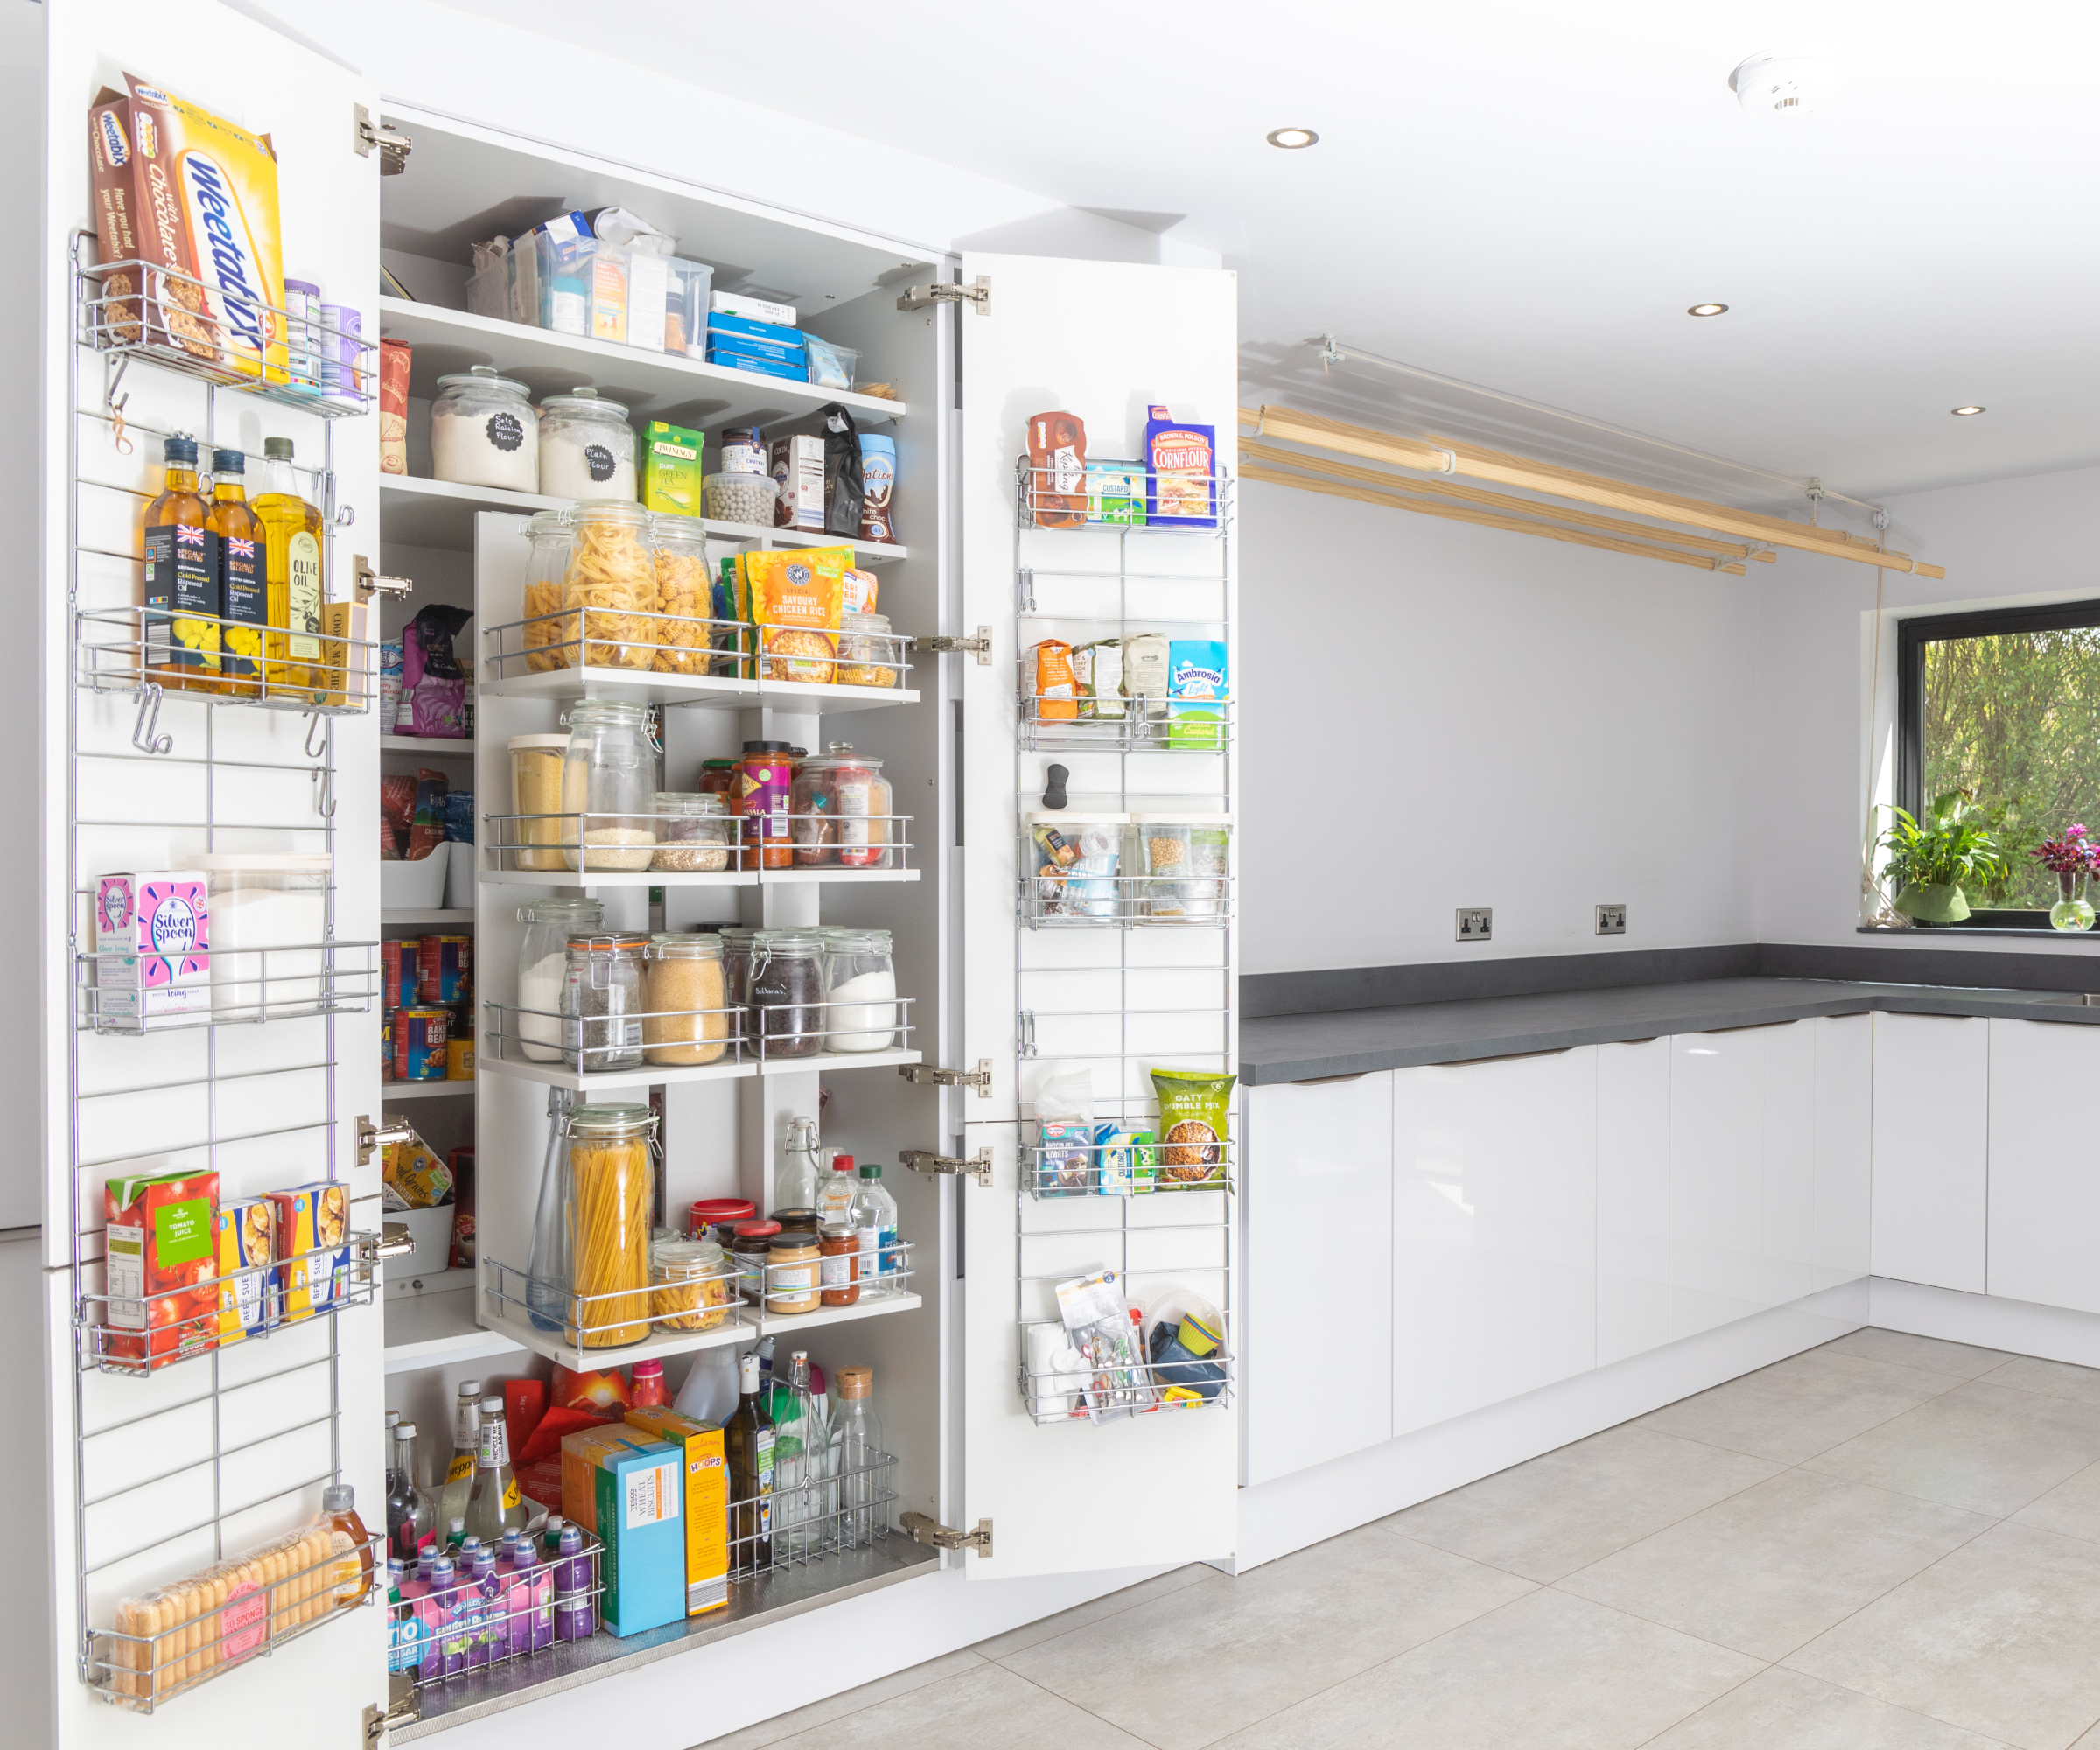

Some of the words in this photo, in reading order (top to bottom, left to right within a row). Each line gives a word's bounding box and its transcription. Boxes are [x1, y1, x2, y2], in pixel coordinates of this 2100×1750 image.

[137, 88, 168, 101] Weetabix
[102, 113, 127, 165] Weetabix
[93, 131, 104, 172] Chocolate
[100, 188, 111, 206] your
[113, 188, 125, 208] Have
[117, 208, 130, 226] you
[149, 163, 177, 262] Chocolate
[166, 192, 179, 231] with
[104, 206, 123, 259] Weetabix?
[124, 226, 134, 248] had
[186, 156, 262, 351] Weetabix
[495, 416, 513, 426] Self
[495, 424, 522, 437] Raising
[1159, 433, 1179, 441] BROWN
[1184, 433, 1205, 443] POLSON
[587, 448, 608, 460] Plain
[658, 444, 692, 458] TWININGS
[1153, 447, 1209, 469] CORNFLOUR
[588, 459, 610, 470] Flour
[658, 469, 687, 480] GREEN
[660, 476, 676, 486] TEA
[1103, 484, 1128, 493] CUSTARD
[177, 549, 204, 557] SPECIALLY
[177, 554, 203, 562] SELECTED
[229, 561, 254, 569] SPECIALLY
[229, 566, 253, 574] SELECTED
[293, 559, 318, 576] OLIVE
[178, 578, 203, 588] Rapeseed
[192, 574, 210, 583] Pressed
[293, 574, 308, 587] OIL
[230, 590, 253, 598] Rapeseed
[243, 585, 260, 594] Pressed
[782, 595, 817, 606] SAVOURY
[773, 605, 807, 615] CHICKEN
[810, 606, 826, 616] RICE
[1177, 668, 1220, 683] Ambrosia
[1188, 683, 1208, 695] Light
[1184, 727, 1215, 735] Custard
[106, 895, 125, 903] Silver
[106, 903, 125, 912] spoon
[155, 914, 192, 928] Silver
[156, 928, 194, 945] spoon
[167, 989, 187, 999] Icing
[428, 1035, 446, 1043] BEAN
[405, 1173, 429, 1199] Grains
[169, 1219, 195, 1230] TOMATO
[175, 1227, 191, 1238] JUICE
[493, 1425, 497, 1434] ME
[691, 1457, 721, 1472] HOOPS
[225, 1619, 235, 1630] 30
[236, 1605, 264, 1625] SPONGE
[388, 1621, 418, 1641] no
[388, 1646, 418, 1660] SUGAR
